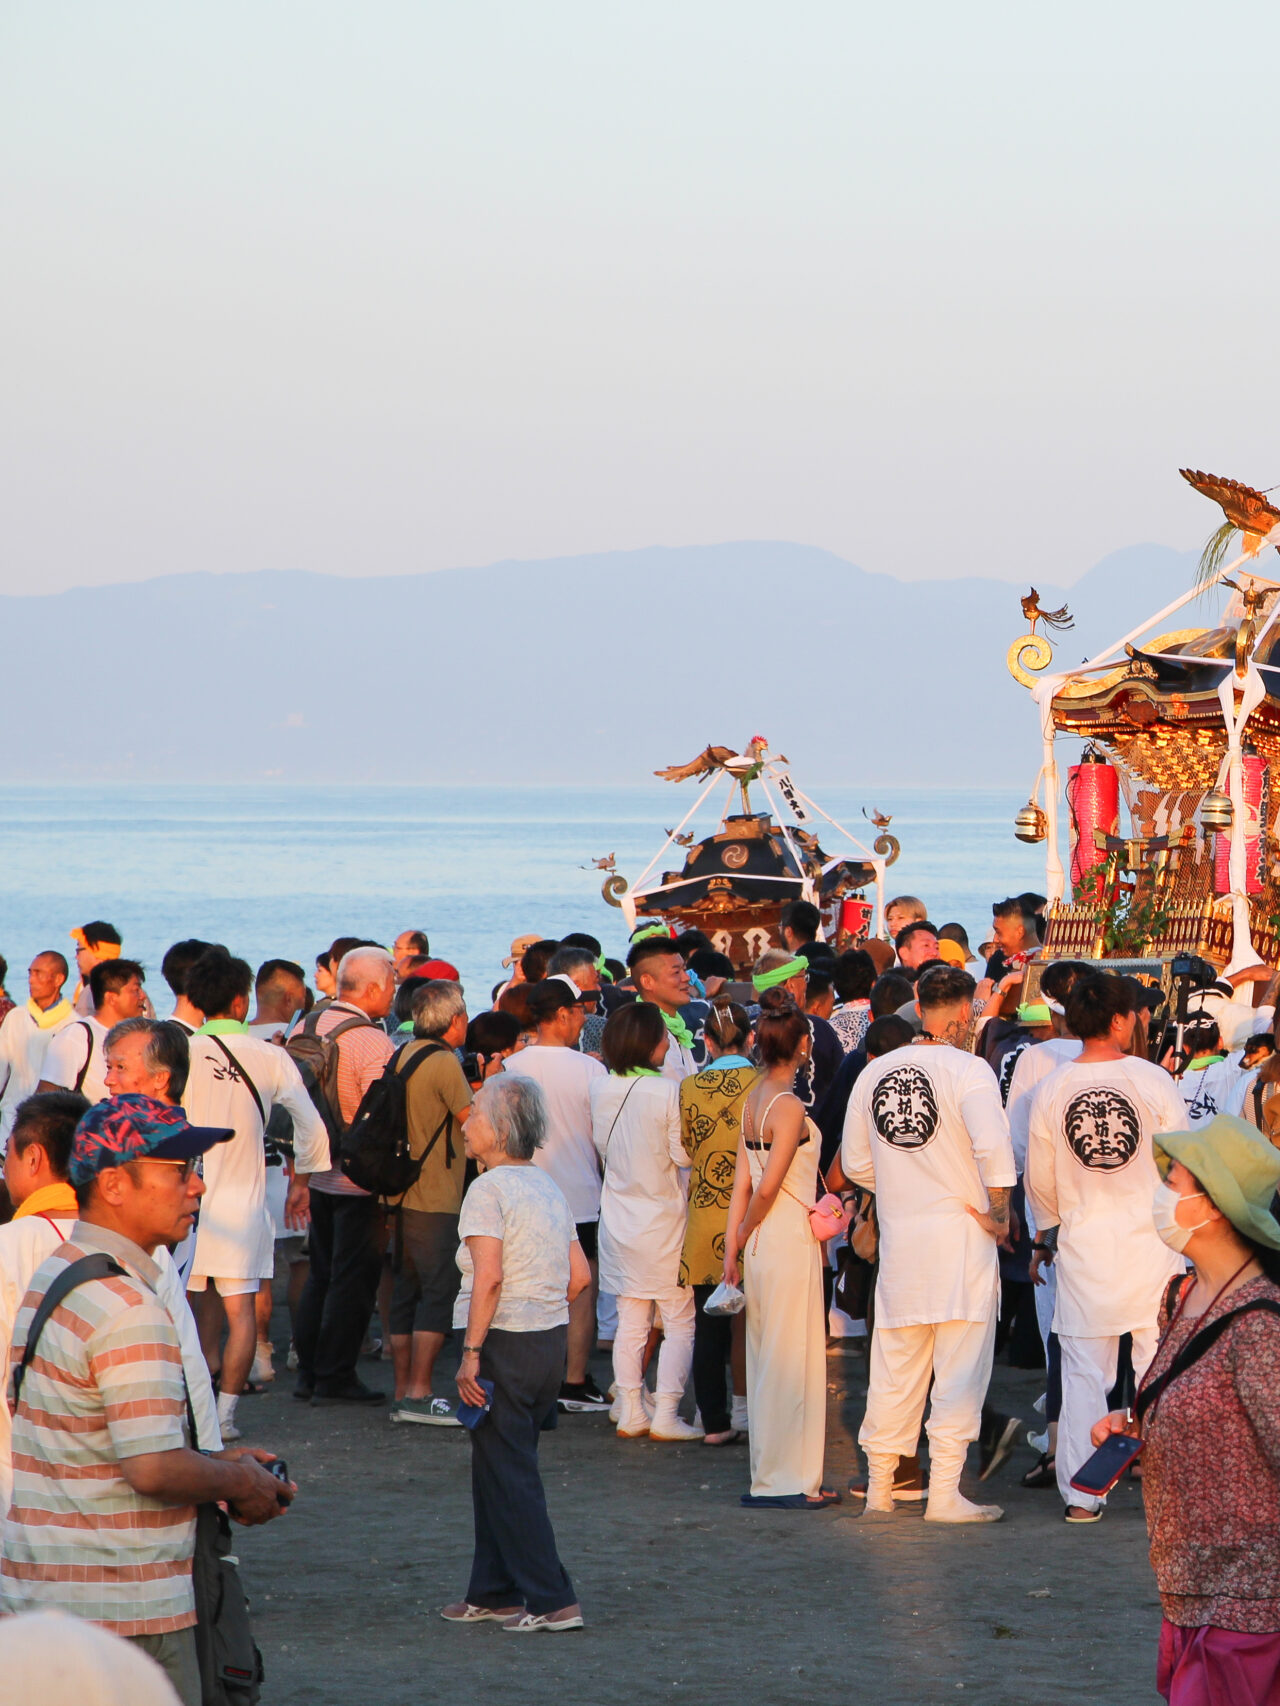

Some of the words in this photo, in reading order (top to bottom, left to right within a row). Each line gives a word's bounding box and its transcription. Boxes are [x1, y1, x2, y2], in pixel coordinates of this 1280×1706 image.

[897, 1078, 914, 1135] 海坊主
[1091, 1101, 1113, 1156] 海坊主
